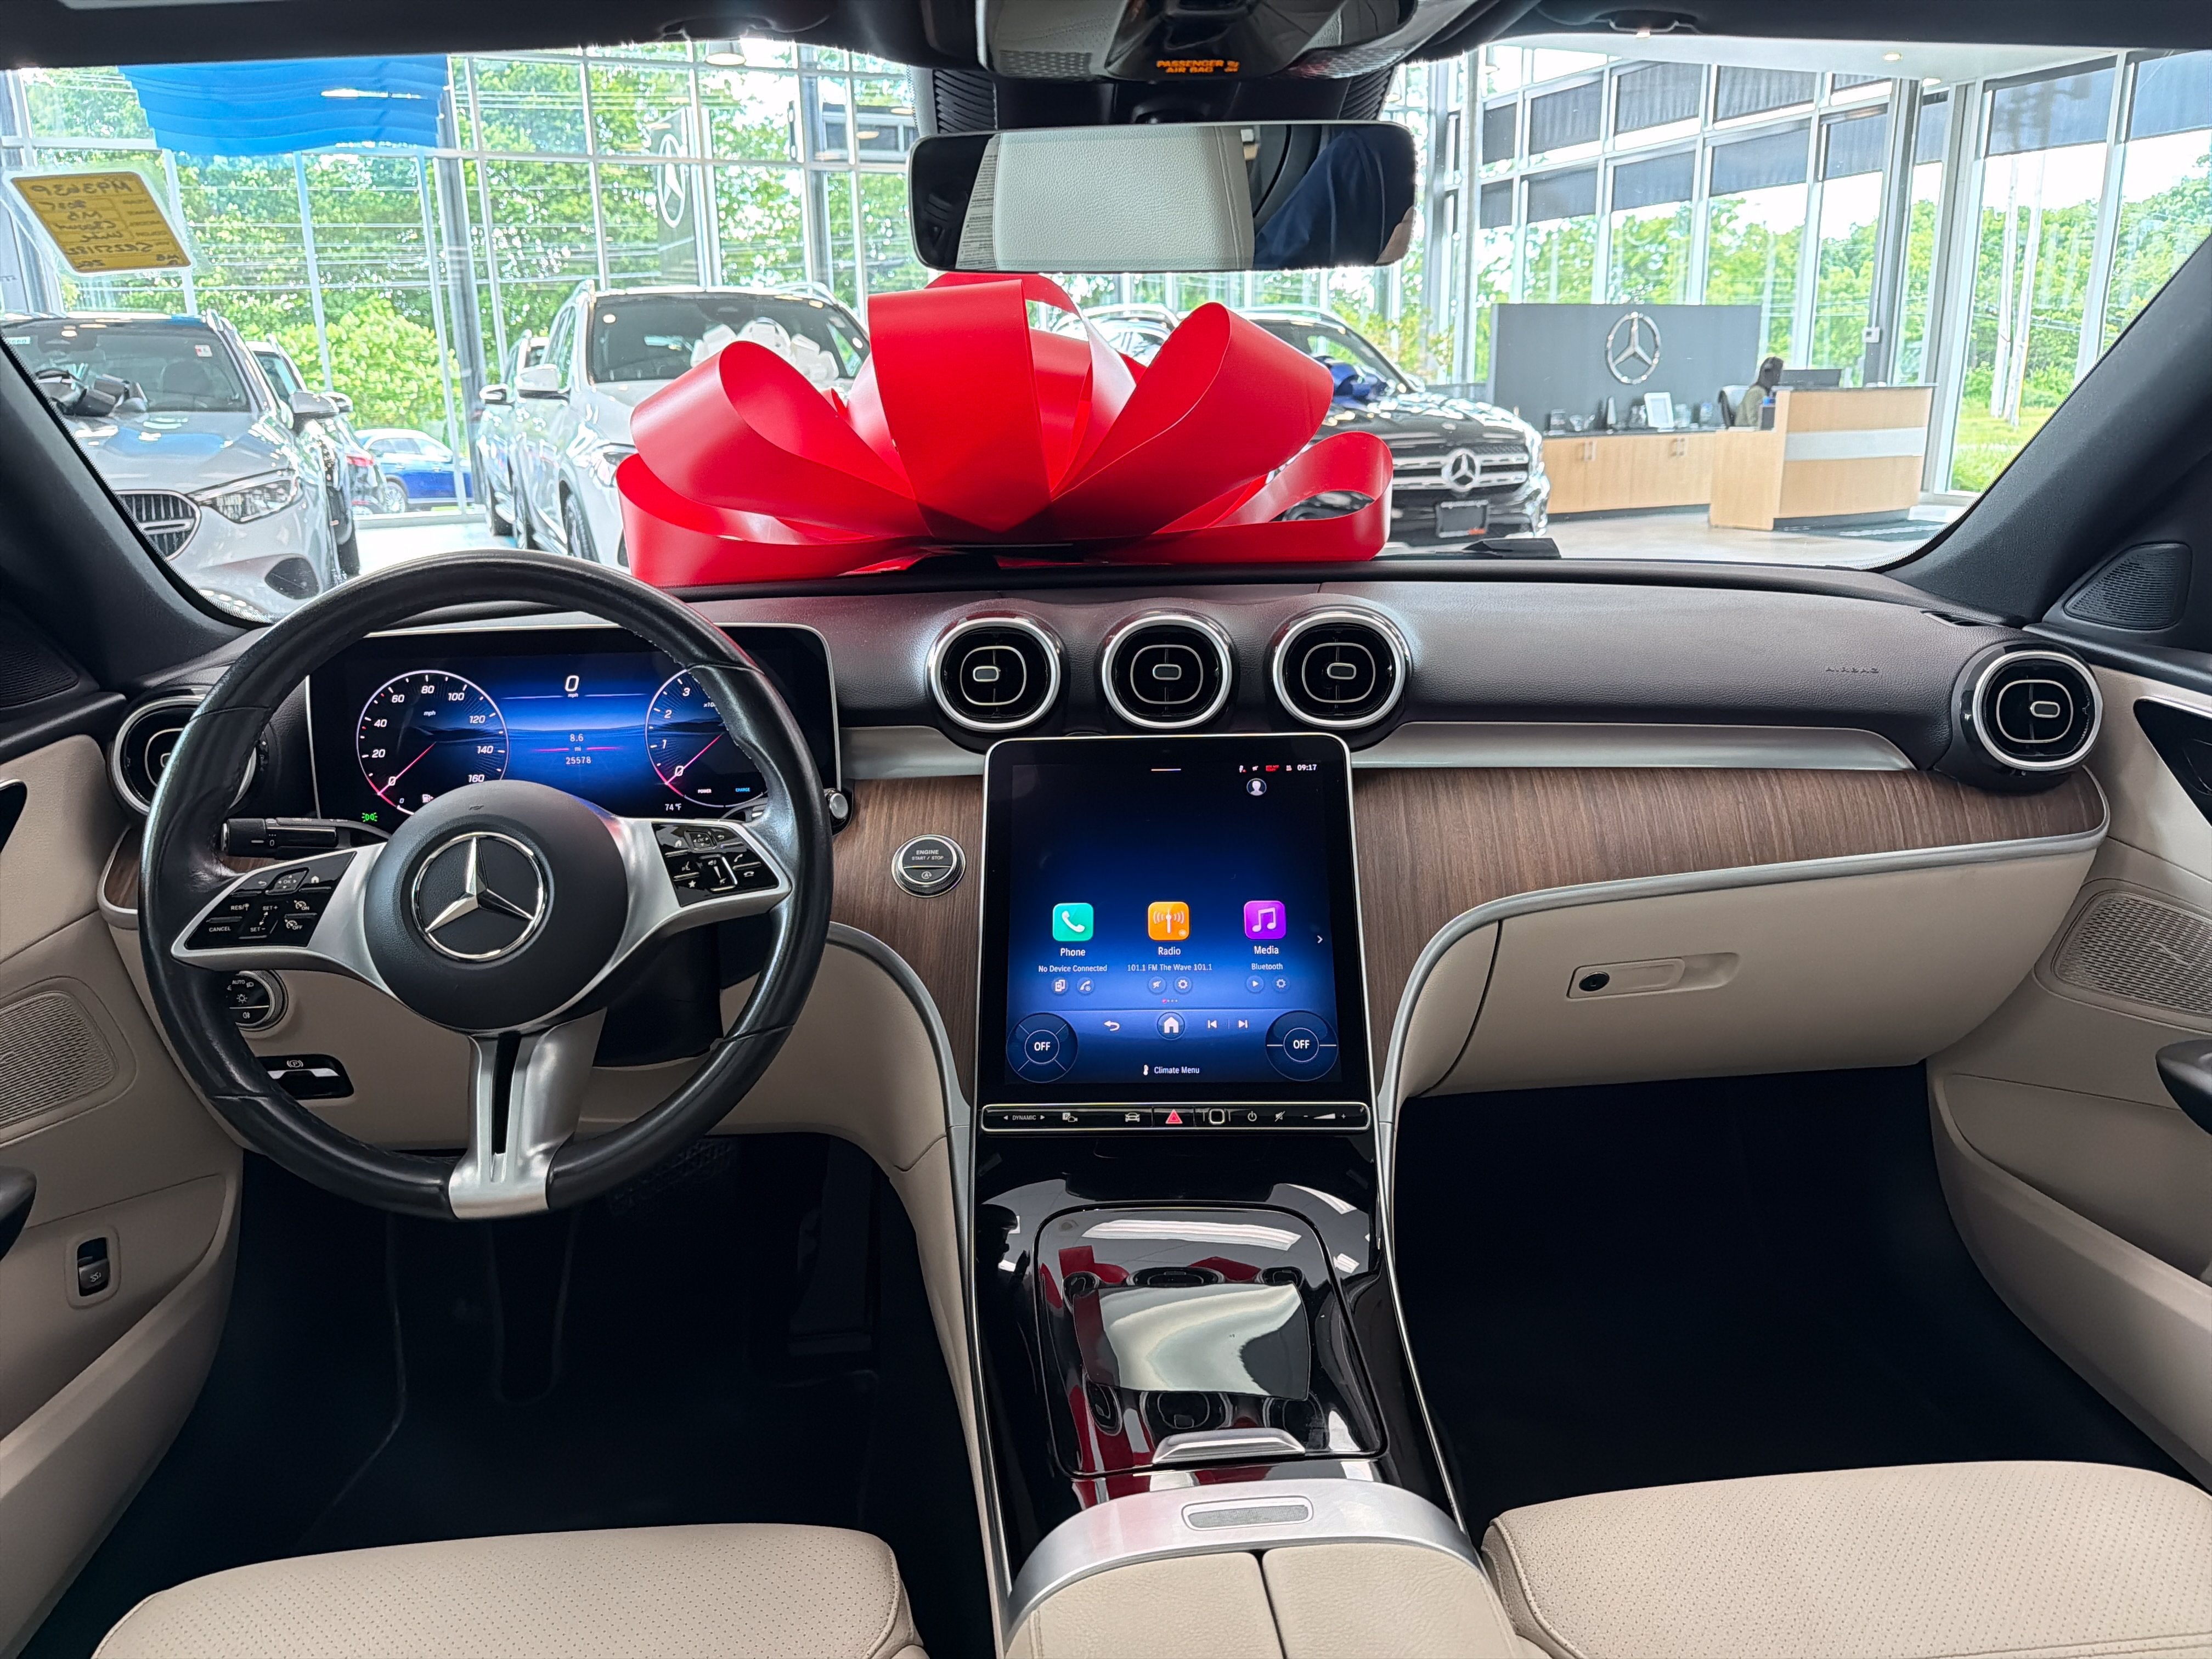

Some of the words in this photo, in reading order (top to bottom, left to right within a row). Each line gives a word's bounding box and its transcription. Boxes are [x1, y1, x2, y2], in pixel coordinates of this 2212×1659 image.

[565, 675, 580, 692] 0
[421, 686, 435, 695] 80
[682, 687, 691, 697] 3
[391, 695, 405, 703] 60
[448, 693, 465, 701] 100
[664, 709, 673, 719] 2
[374, 719, 387, 728] 40
[469, 715, 486, 724] 120
[569, 733, 584, 742] 8.6
[662, 740, 667, 749] 1
[371, 749, 386, 758] 20
[477, 746, 494, 754] 140
[566, 756, 591, 765] 25578
[674, 765, 684, 777] 0
[387, 776, 397, 786] 0
[468, 774, 485, 783] 160
[1060, 947, 1086, 957] Phone
[1158, 946, 1181, 955] Radio
[1254, 945, 1279, 955] Media
[1034, 1041, 1051, 1052] OFF
[1293, 1039, 1310, 1049] OFF
[1154, 1065, 1180, 1075] Climate
[1181, 1065, 1200, 1074] Menu
